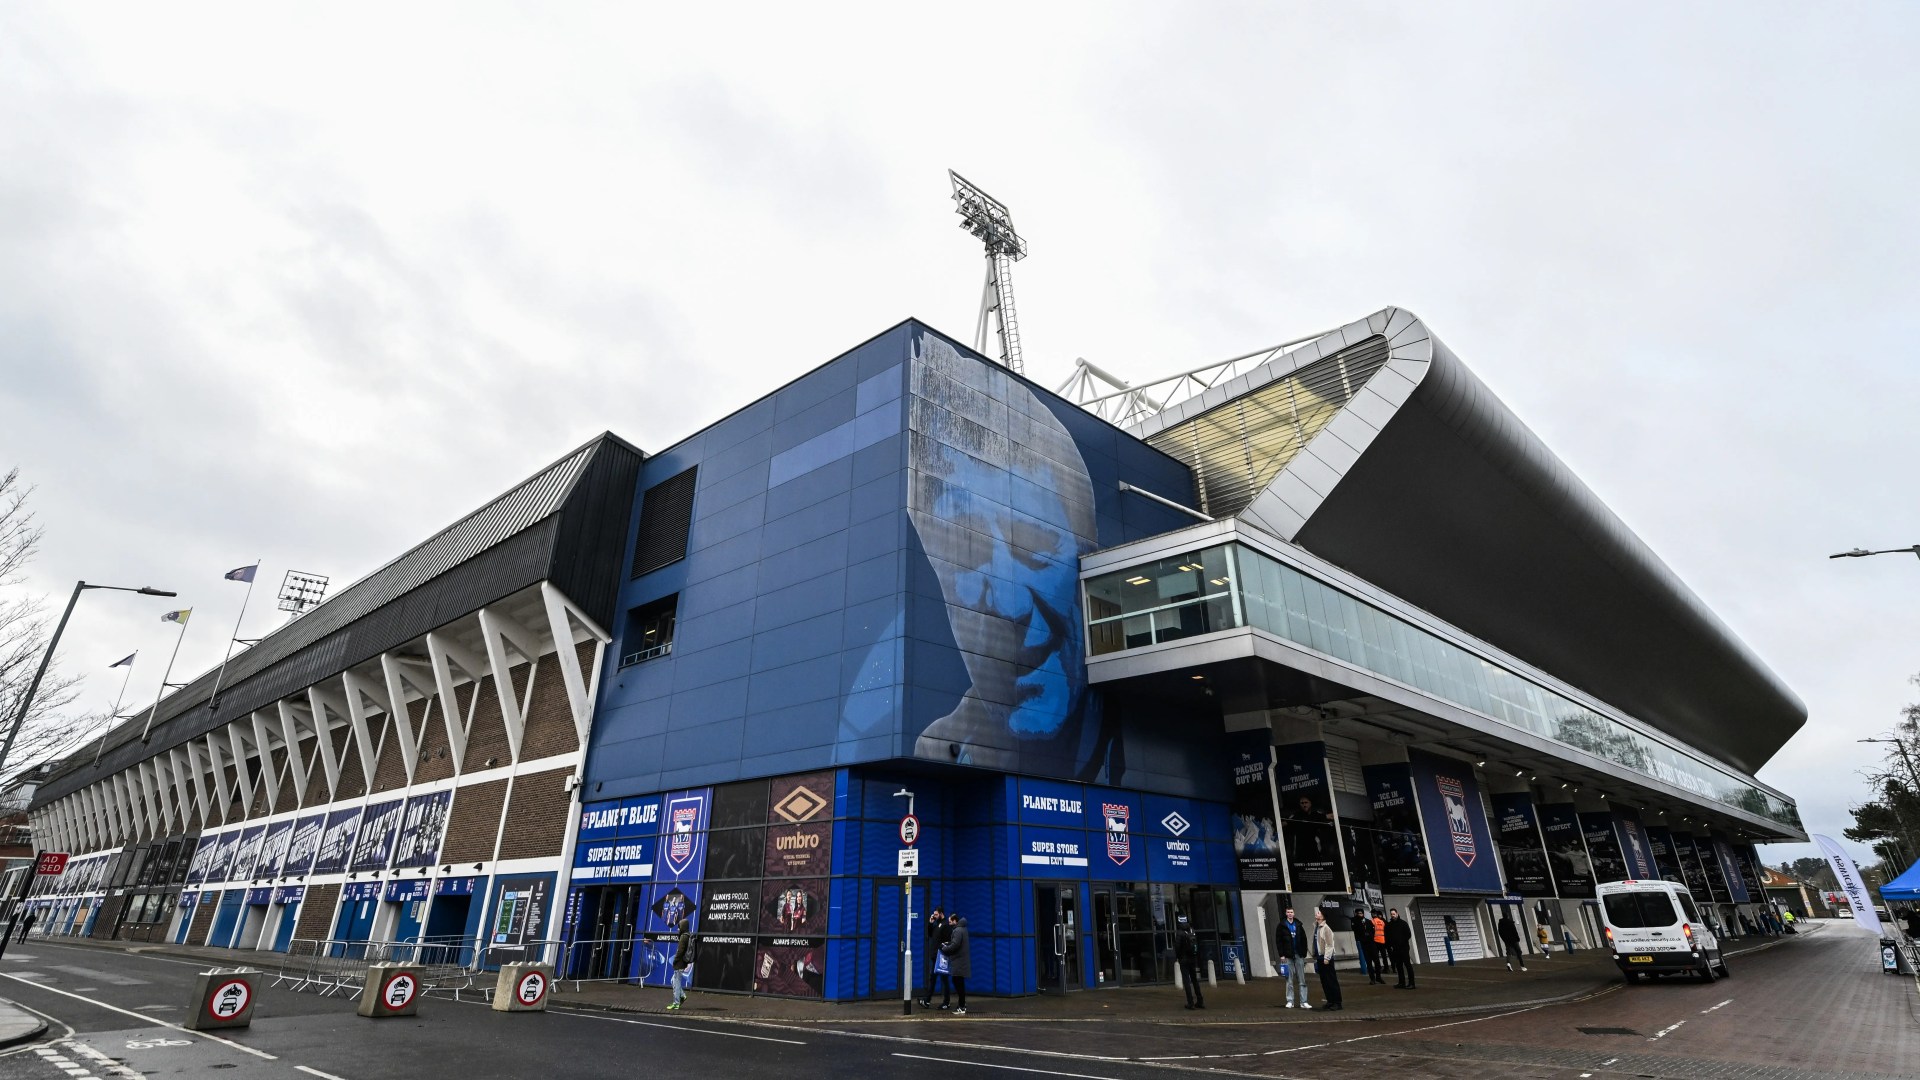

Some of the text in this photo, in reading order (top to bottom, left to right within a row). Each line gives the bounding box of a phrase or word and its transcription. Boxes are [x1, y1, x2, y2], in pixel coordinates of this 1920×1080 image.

[1234, 762, 1264, 776] 'PACKED
[1236, 771, 1264, 786] OUT PR'
[1282, 778, 1320, 792] NIGHT LIGHTS'
[1378, 790, 1399, 801] 'ICE IN
[1023, 795, 1082, 813] PLANET BLUE
[1373, 797, 1405, 810] HIS VEINS'
[587, 804, 659, 829] PLANET BLUE
[776, 831, 820, 850] umbro
[1166, 839, 1190, 851] umbro
[587, 844, 642, 862] SUPER STORE
[1032, 841, 1079, 855] SUPER STORE
[43, 855, 59, 863] AD
[1050, 856, 1063, 865] EXIT
[40, 864, 61, 872] SED
[594, 865, 629, 878] ENTRANCE
[712, 892, 749, 901] ALWAYS PROUD.
[709, 902, 750, 911] ALWAYS IPSWICH.
[708, 912, 750, 920] ALWAYS SUFFOLK.
[702, 936, 751, 944] #OURJOURNEYCONTINUES
[772, 938, 790, 946] ALWAYS
